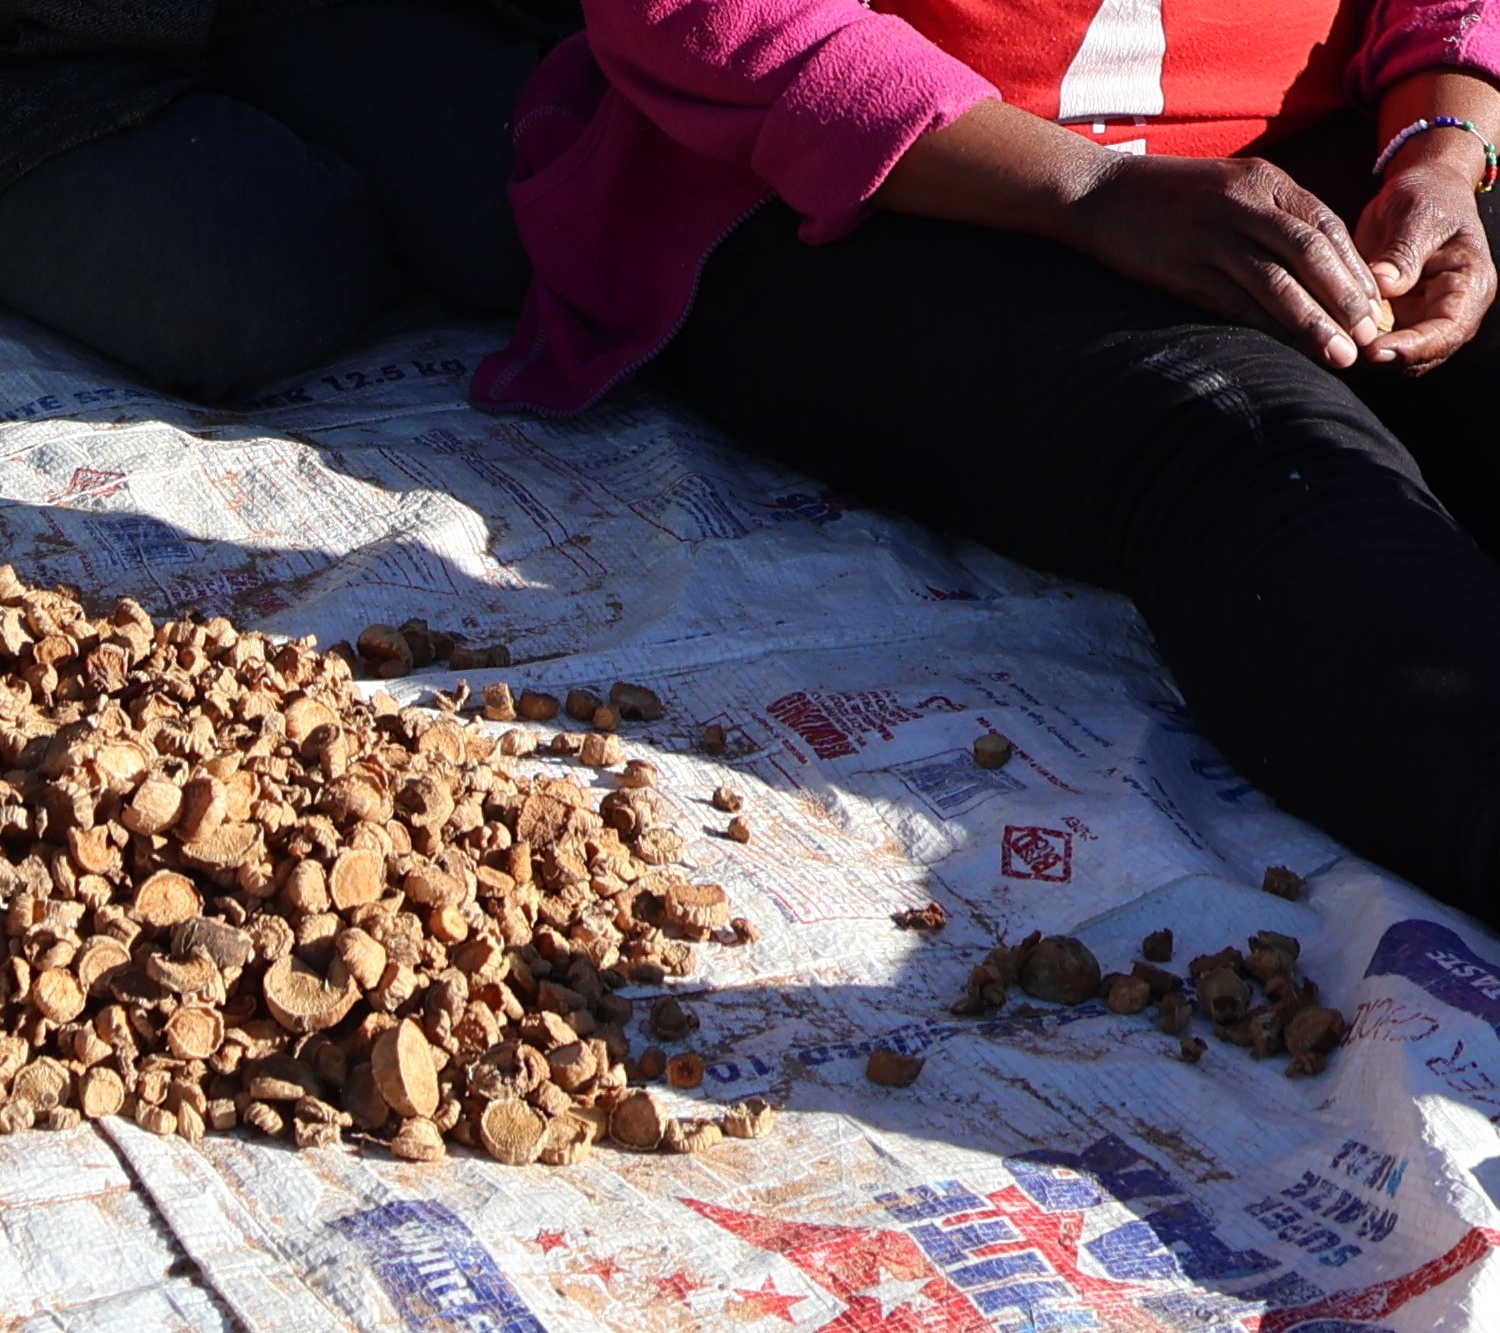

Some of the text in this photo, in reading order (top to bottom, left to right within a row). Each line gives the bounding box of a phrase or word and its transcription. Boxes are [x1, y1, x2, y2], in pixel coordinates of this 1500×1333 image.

[73, 386, 158, 405] STA
[321, 361, 405, 395] 12.5
[412, 355, 470, 381] kg
[395, 1219, 475, 1305] WHITE
[1242, 1195, 1364, 1269] SUPER
